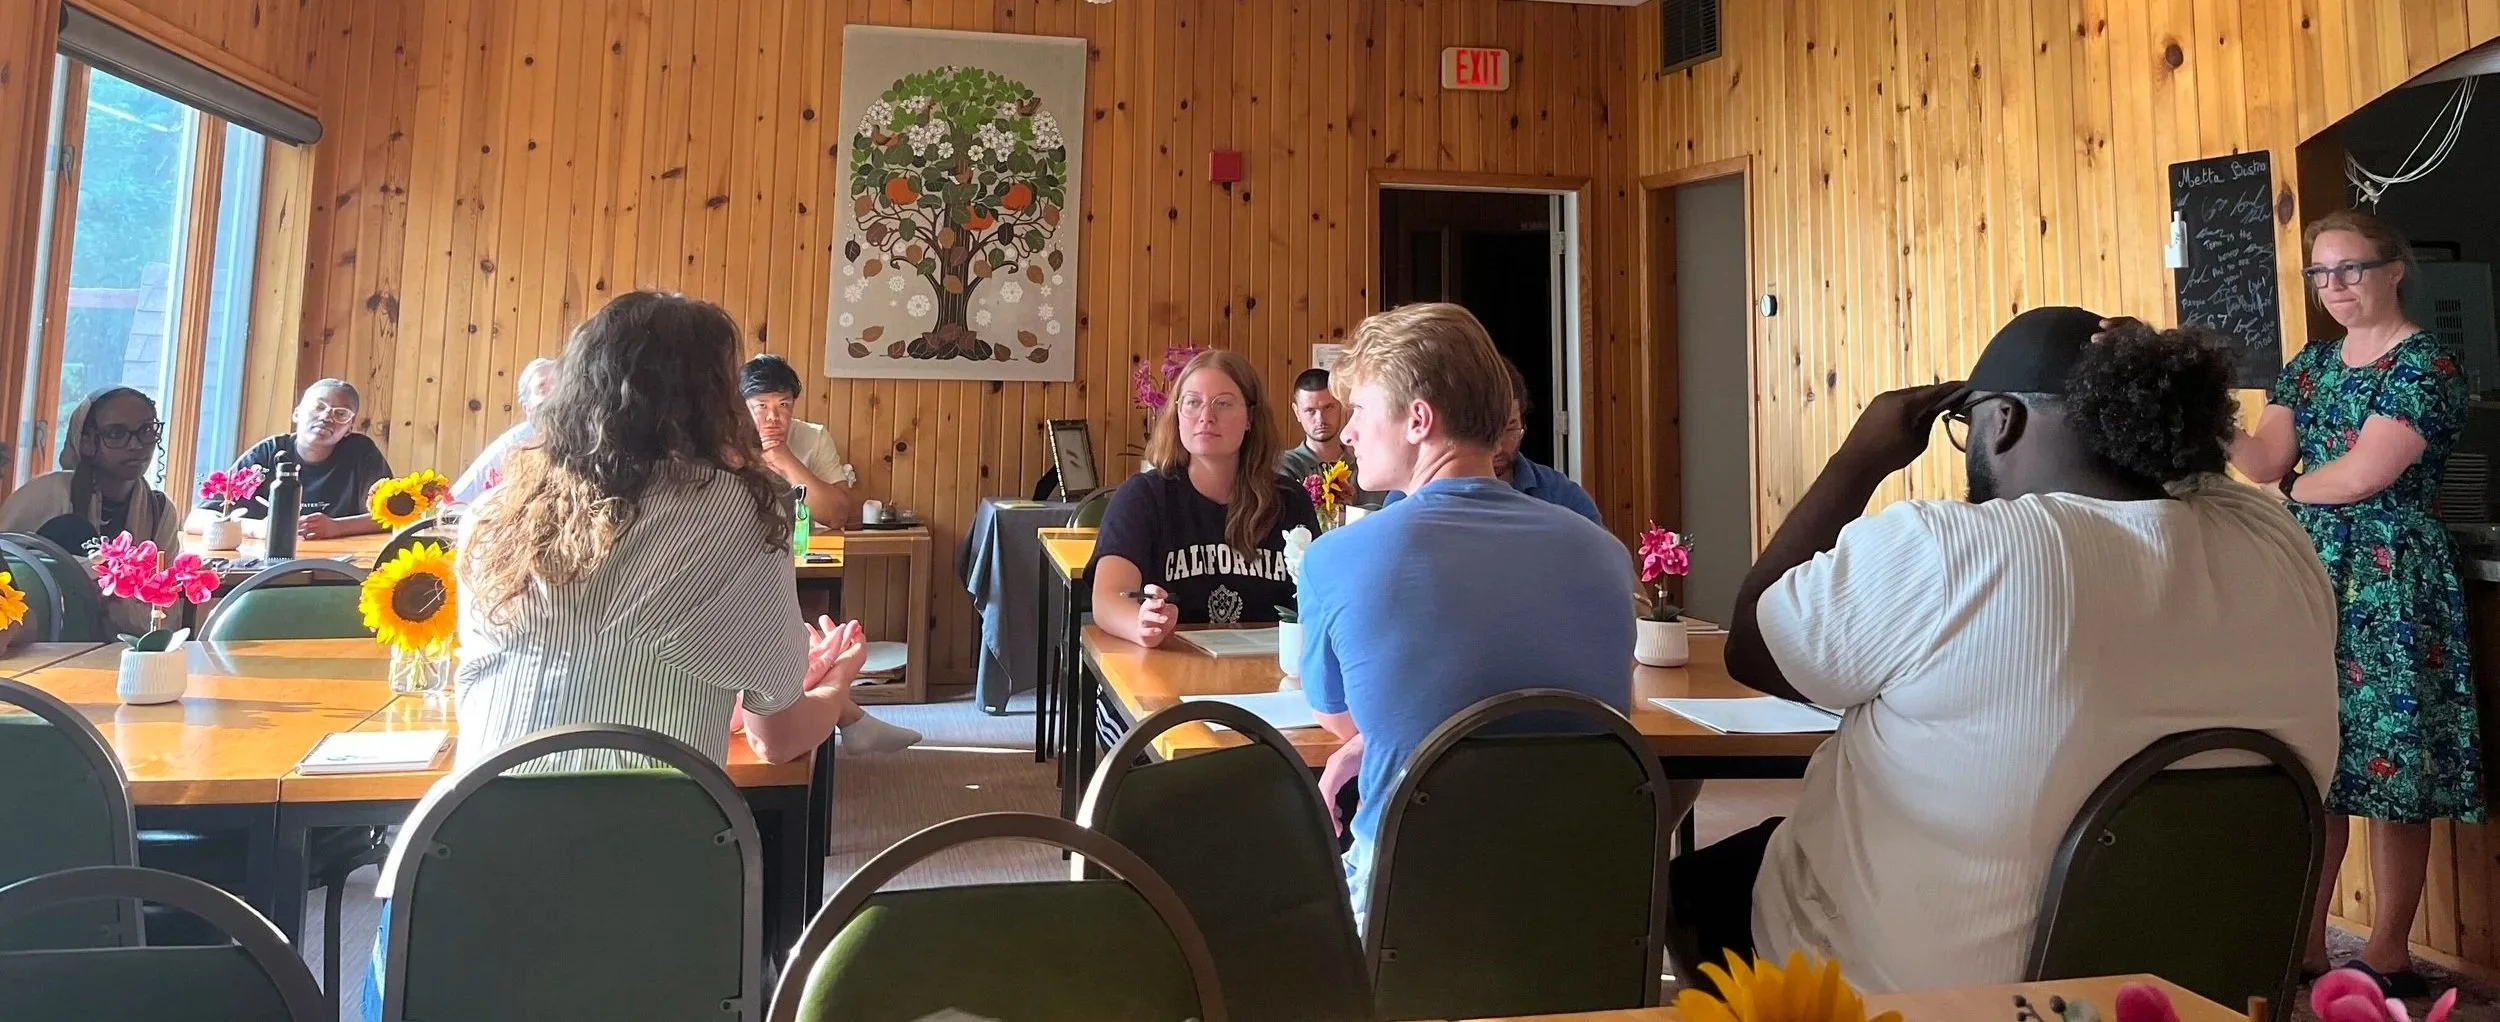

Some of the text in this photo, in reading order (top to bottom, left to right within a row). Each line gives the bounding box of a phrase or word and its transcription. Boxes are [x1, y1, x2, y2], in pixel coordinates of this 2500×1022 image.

[1456, 49, 1501, 85] EXIT
[2178, 160, 2266, 188] Metta Bistro
[1165, 544, 1287, 582] CALIFORNIA
